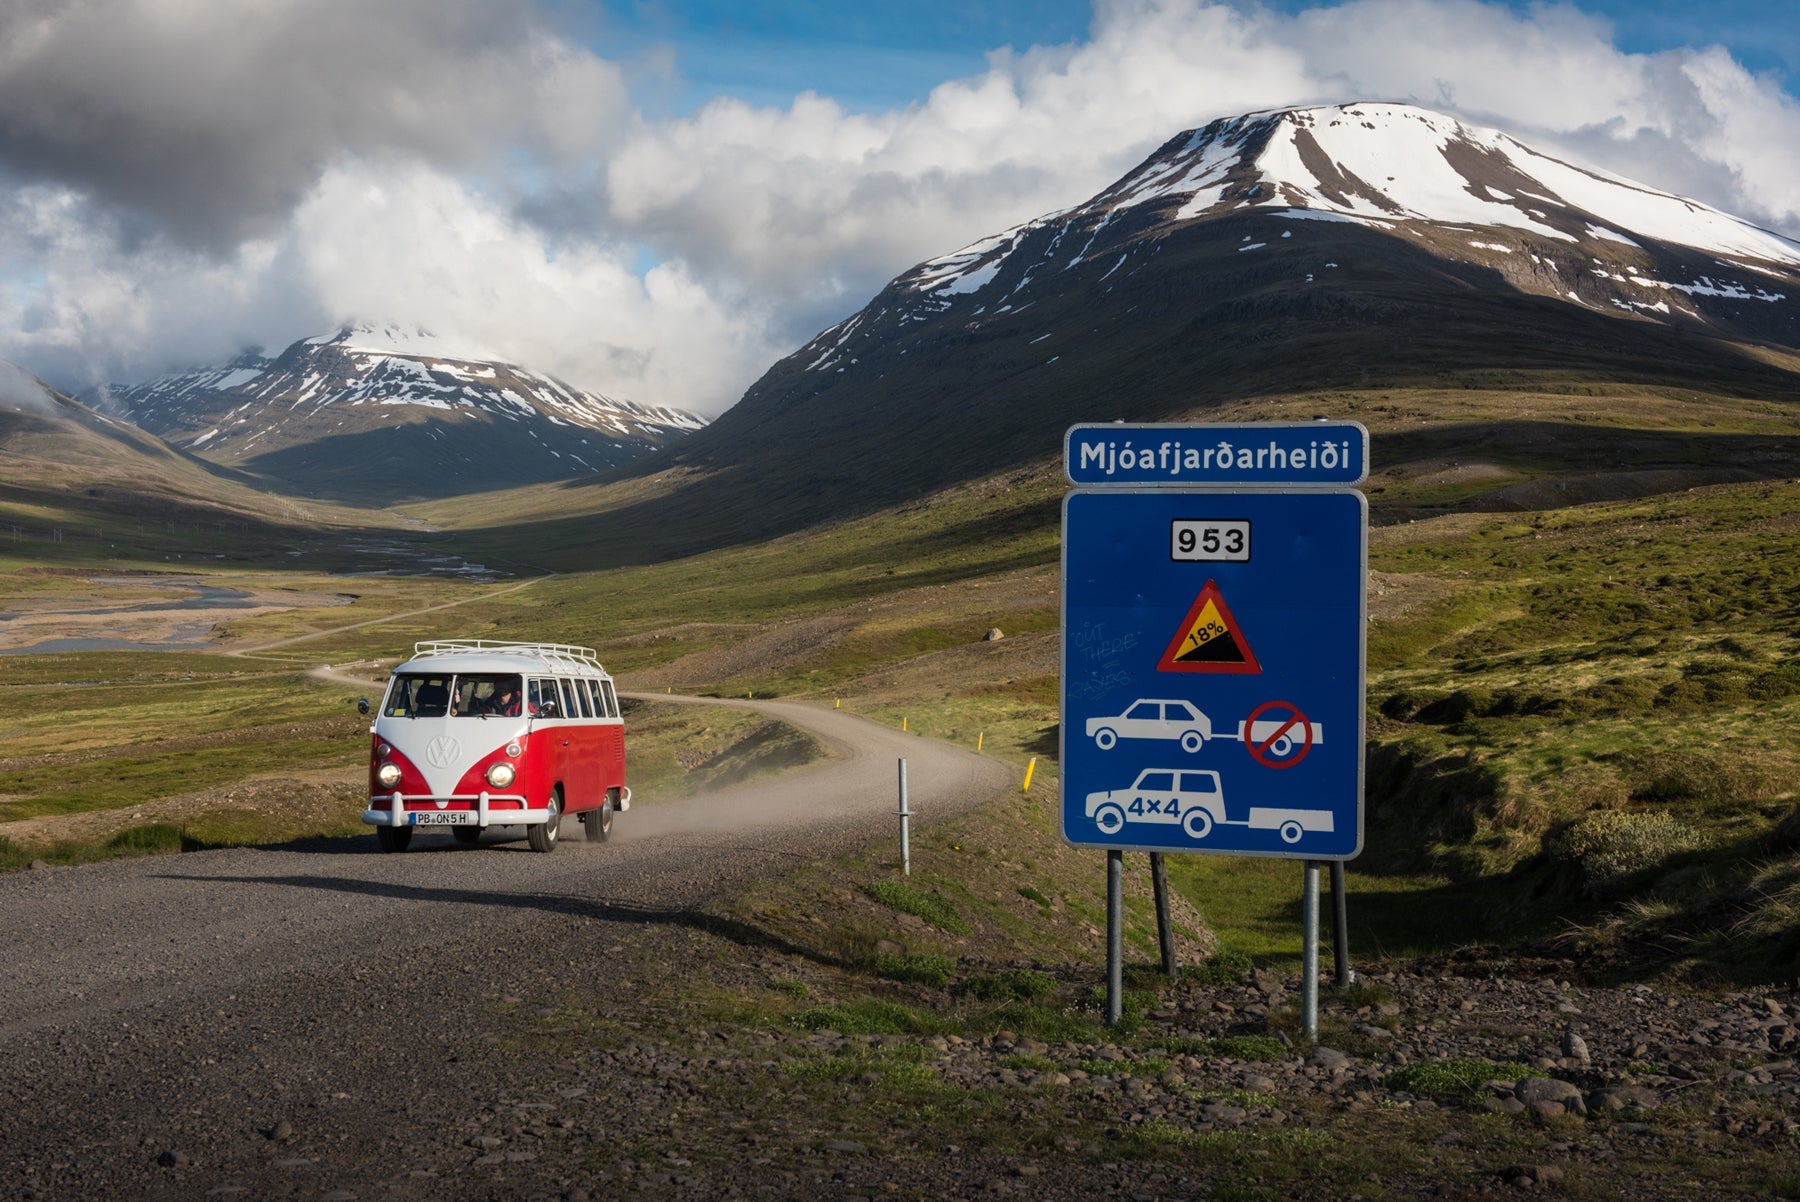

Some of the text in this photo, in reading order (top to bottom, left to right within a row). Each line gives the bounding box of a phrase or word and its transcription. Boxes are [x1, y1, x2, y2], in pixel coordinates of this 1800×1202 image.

[1080, 441, 1349, 475] Mjóafjarðarheiði
[1178, 528, 1244, 553] 953
[1188, 620, 1224, 646] 18%
[425, 736, 461, 769] VW
